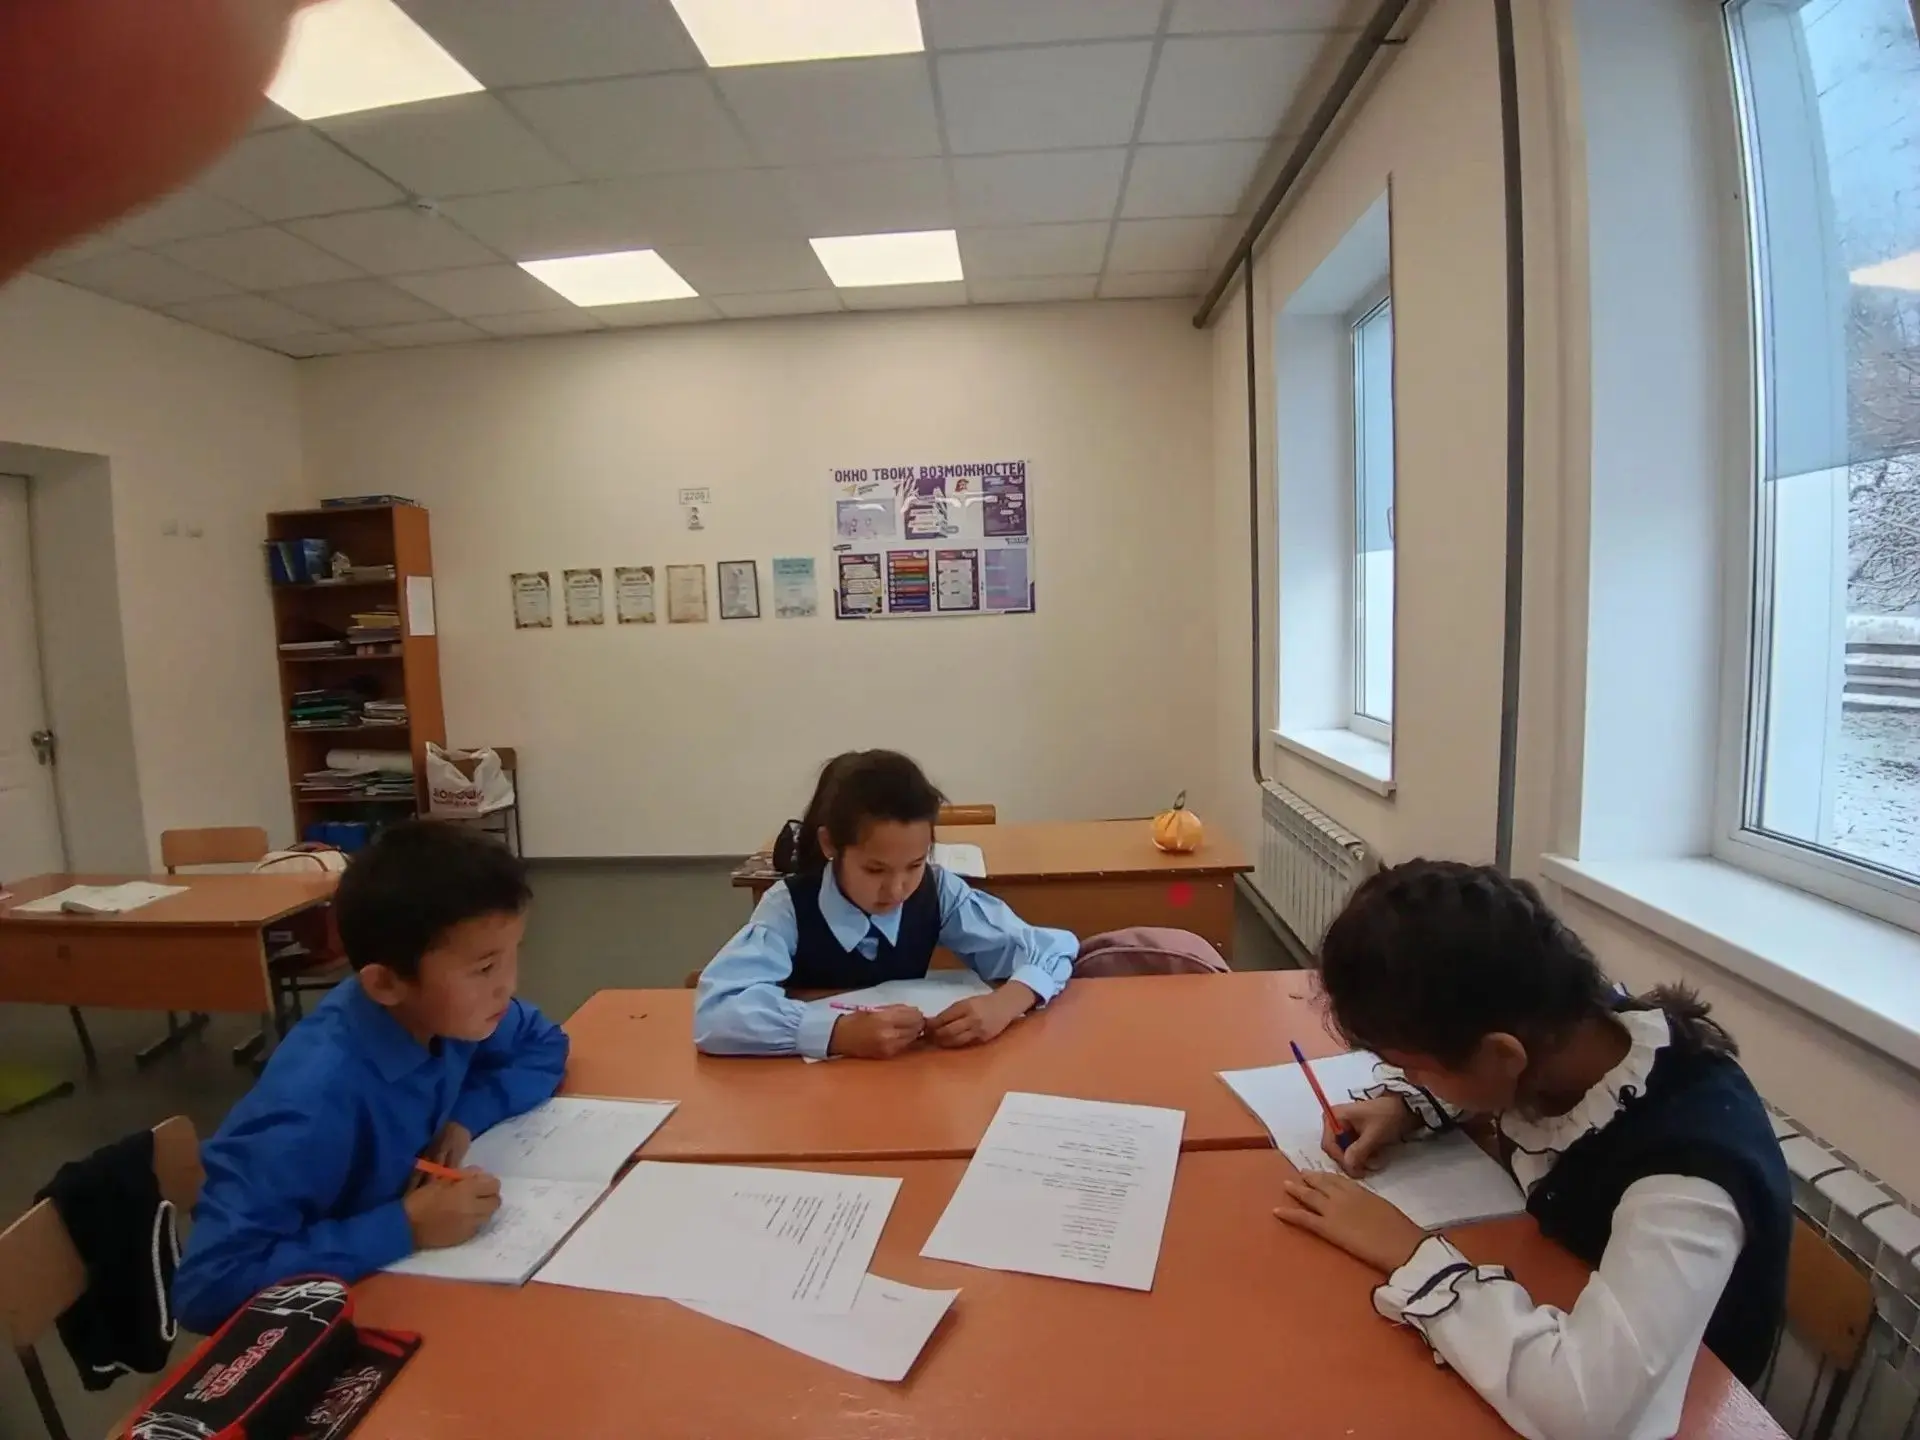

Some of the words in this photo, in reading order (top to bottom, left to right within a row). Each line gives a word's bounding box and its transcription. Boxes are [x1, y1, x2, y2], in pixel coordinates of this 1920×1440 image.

[835, 468, 867, 482] ОКНО
[873, 466, 914, 481] ТВОИХ
[919, 461, 1025, 479] ВОЗМОЖНОСТЕЙ
